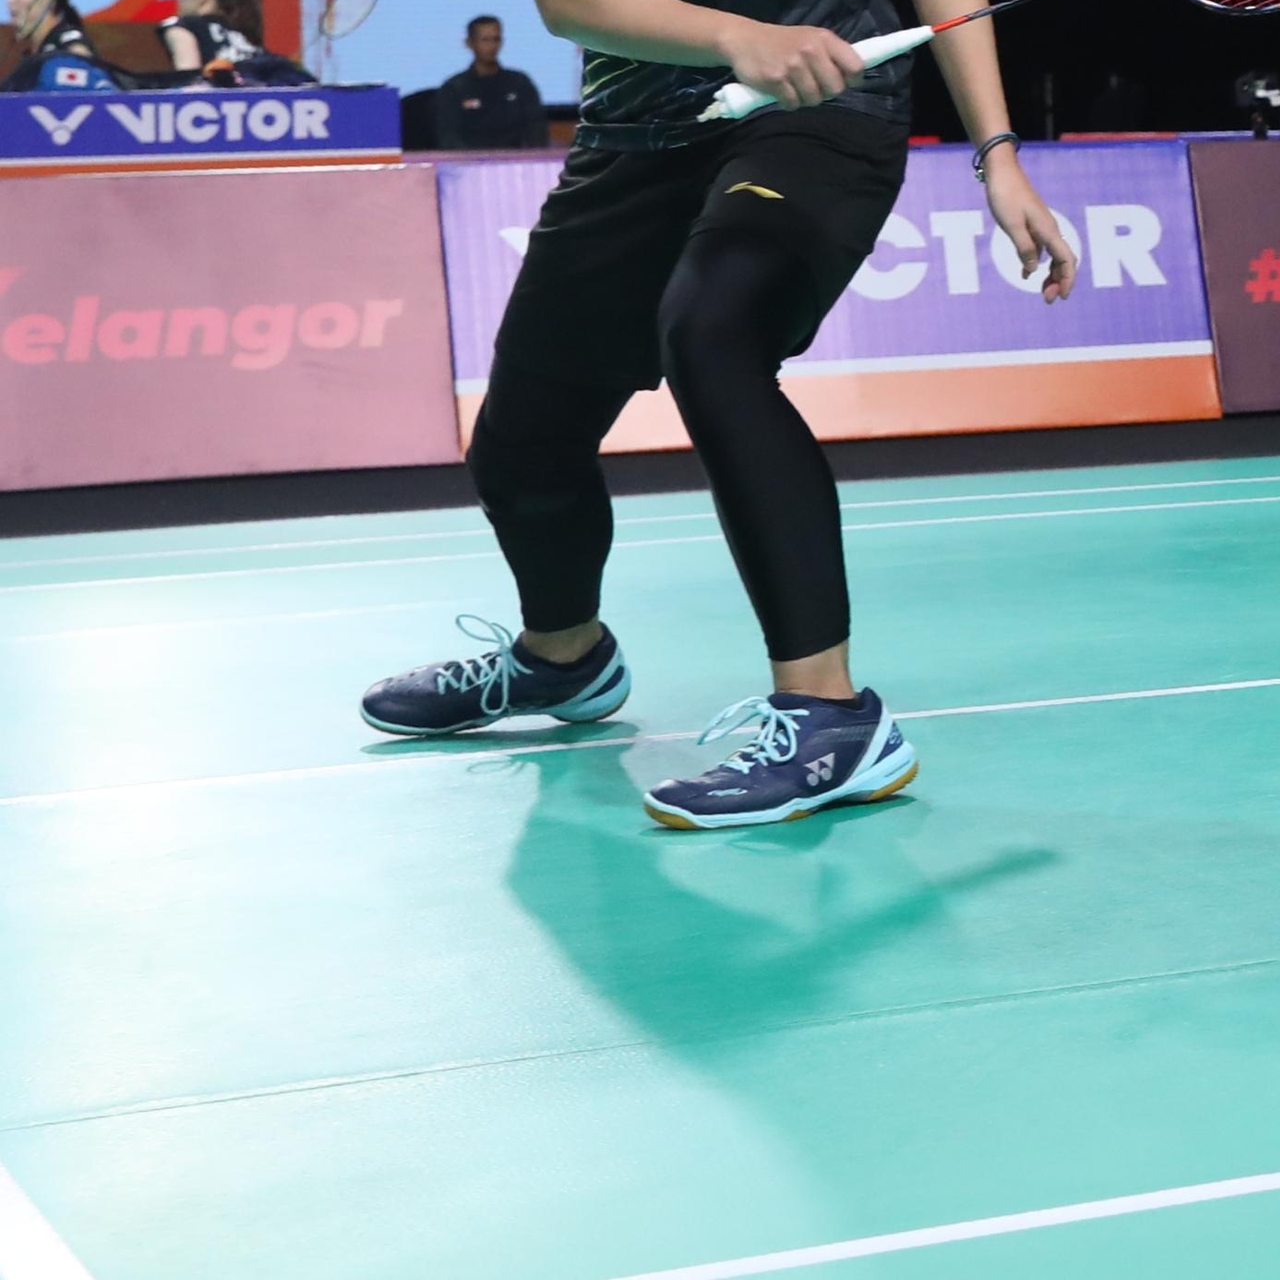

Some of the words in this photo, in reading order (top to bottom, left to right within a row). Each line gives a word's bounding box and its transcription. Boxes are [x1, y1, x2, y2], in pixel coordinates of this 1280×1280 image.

[106, 100, 330, 144] VICTOR
[848, 204, 1168, 301] CTOR
[0, 266, 403, 370] elangor
